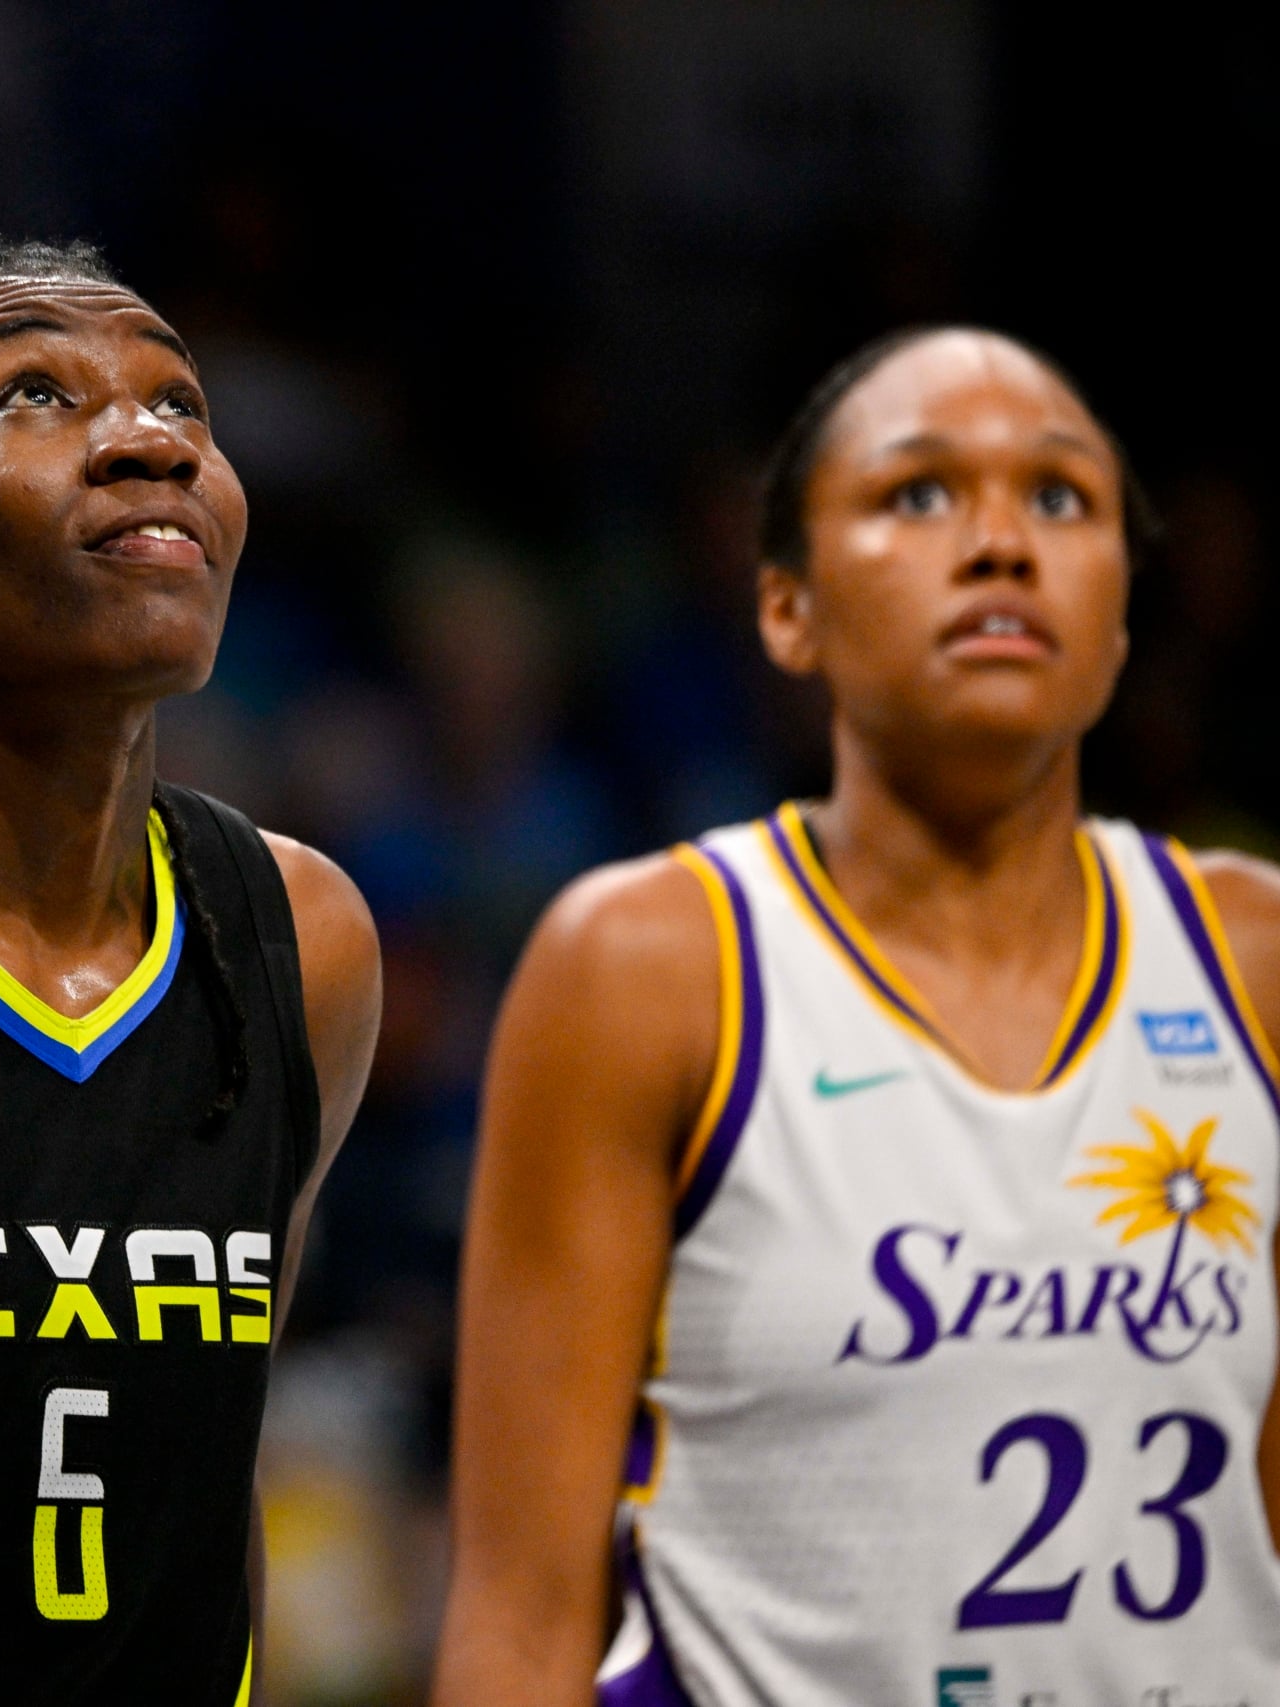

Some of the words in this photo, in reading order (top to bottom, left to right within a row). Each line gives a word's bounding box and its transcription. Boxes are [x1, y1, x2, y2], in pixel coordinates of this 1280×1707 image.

[835, 1221, 1246, 1366] SPARKS
[33, 1387, 110, 1621] 6
[954, 1411, 1232, 1633] 23
